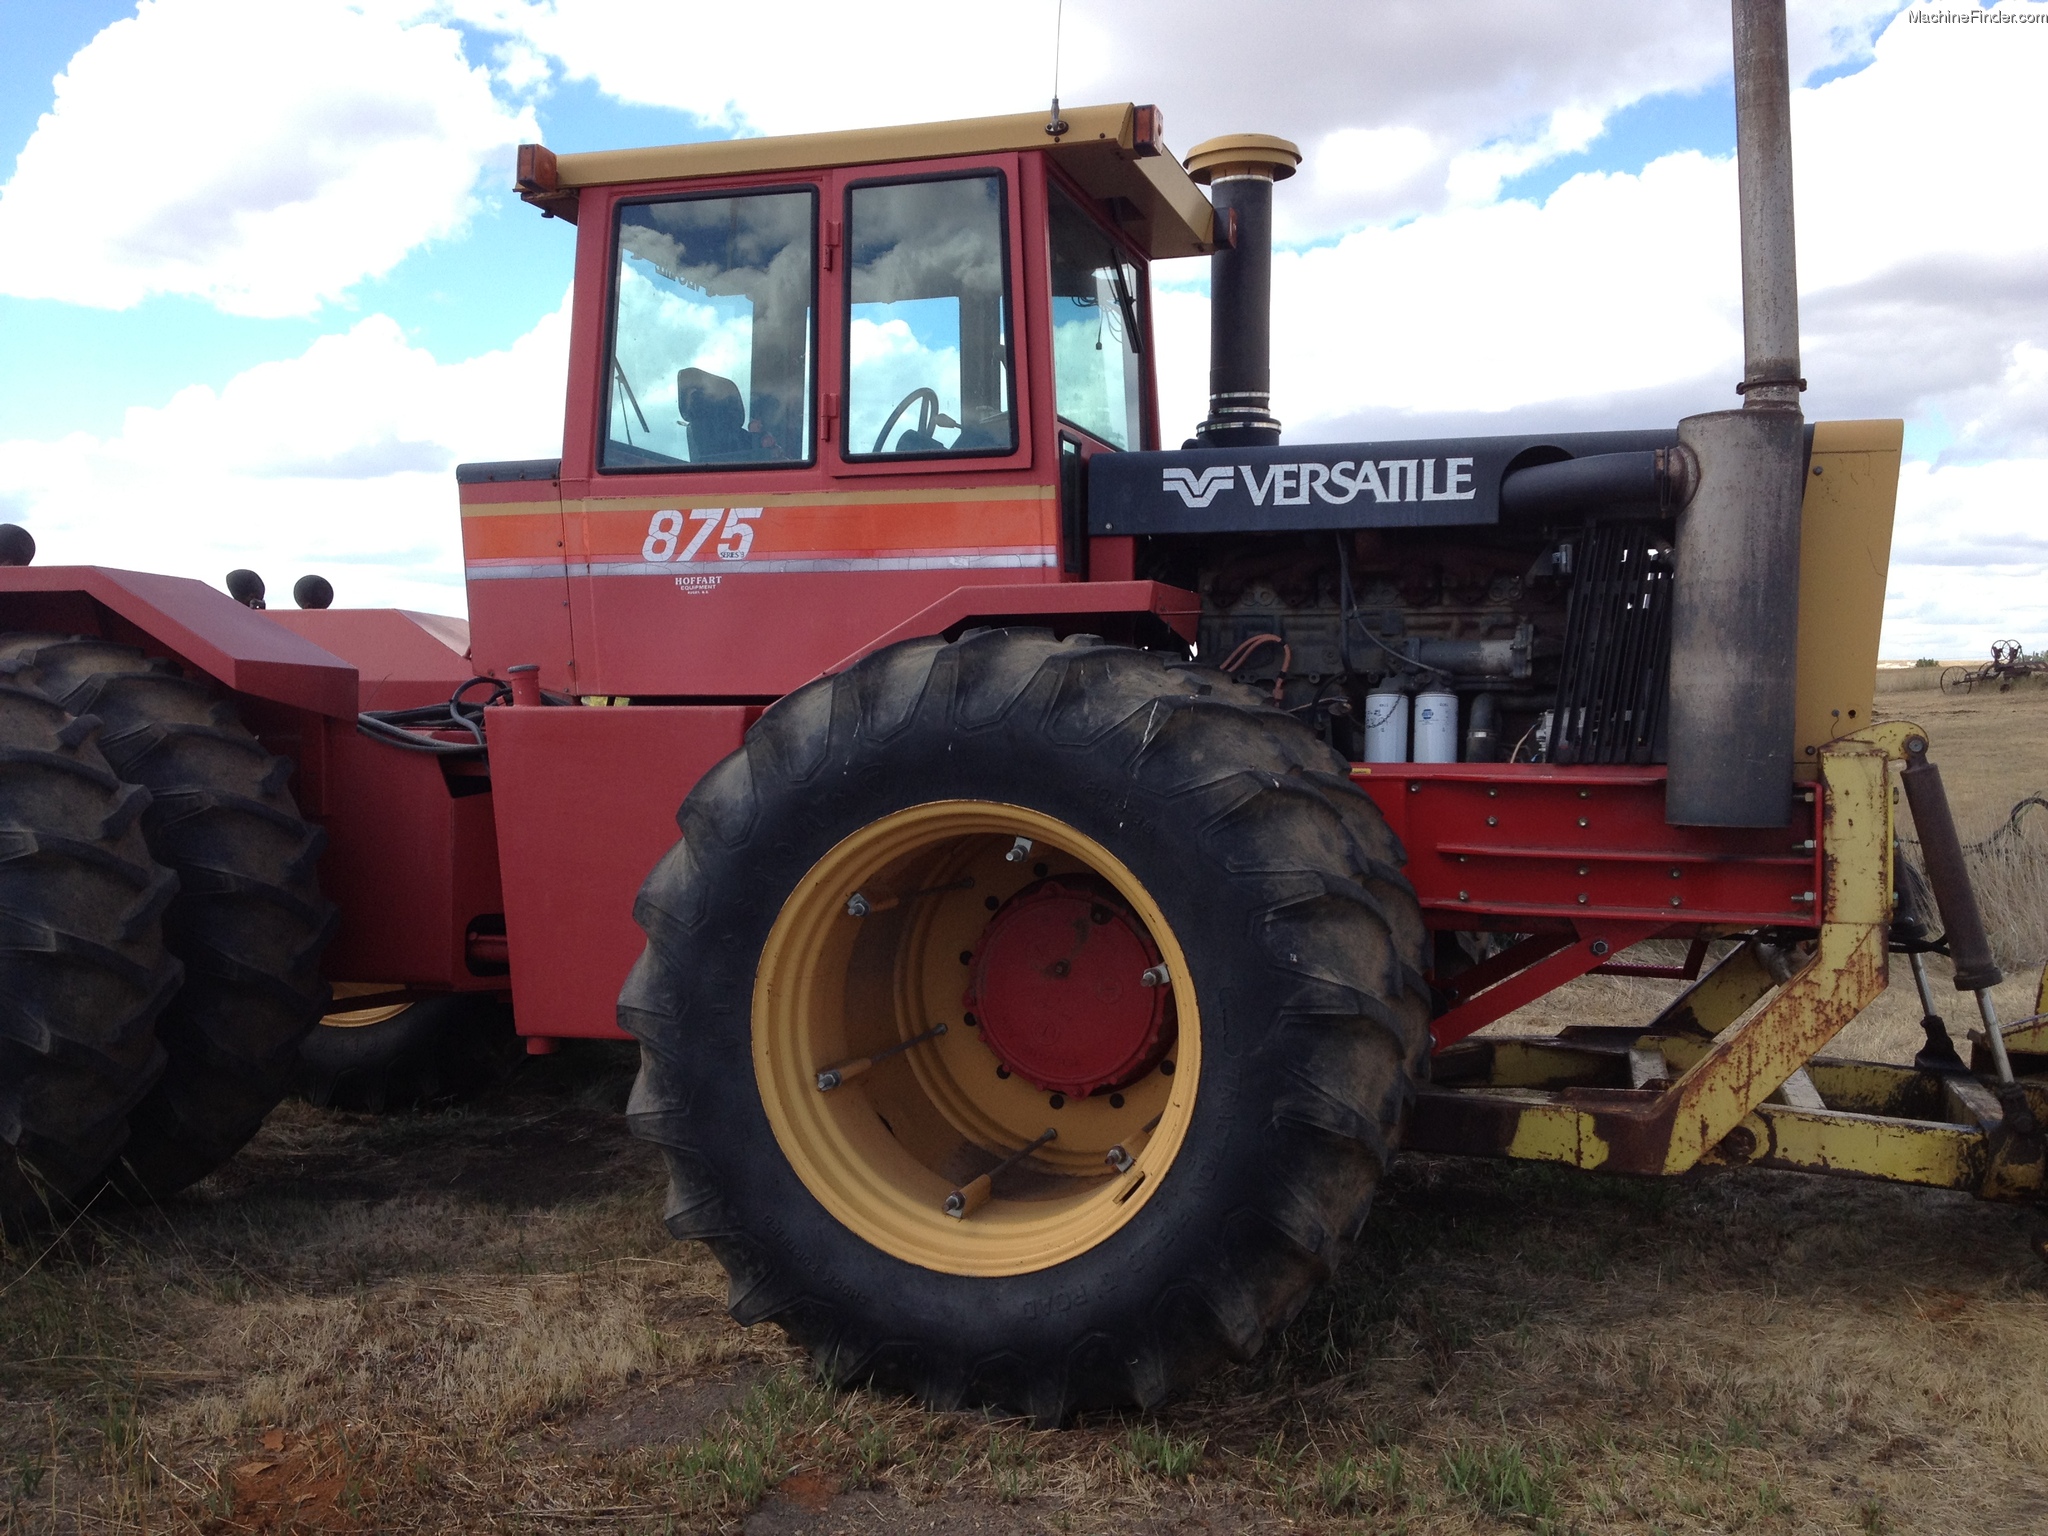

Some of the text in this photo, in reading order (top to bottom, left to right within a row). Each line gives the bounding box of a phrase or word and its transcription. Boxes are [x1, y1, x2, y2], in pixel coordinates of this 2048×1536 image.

[1237, 457, 1477, 506] VERSATILE
[641, 507, 764, 562] 875
[720, 551, 740, 559] SERIES
[675, 575, 723, 586] HOFFART
